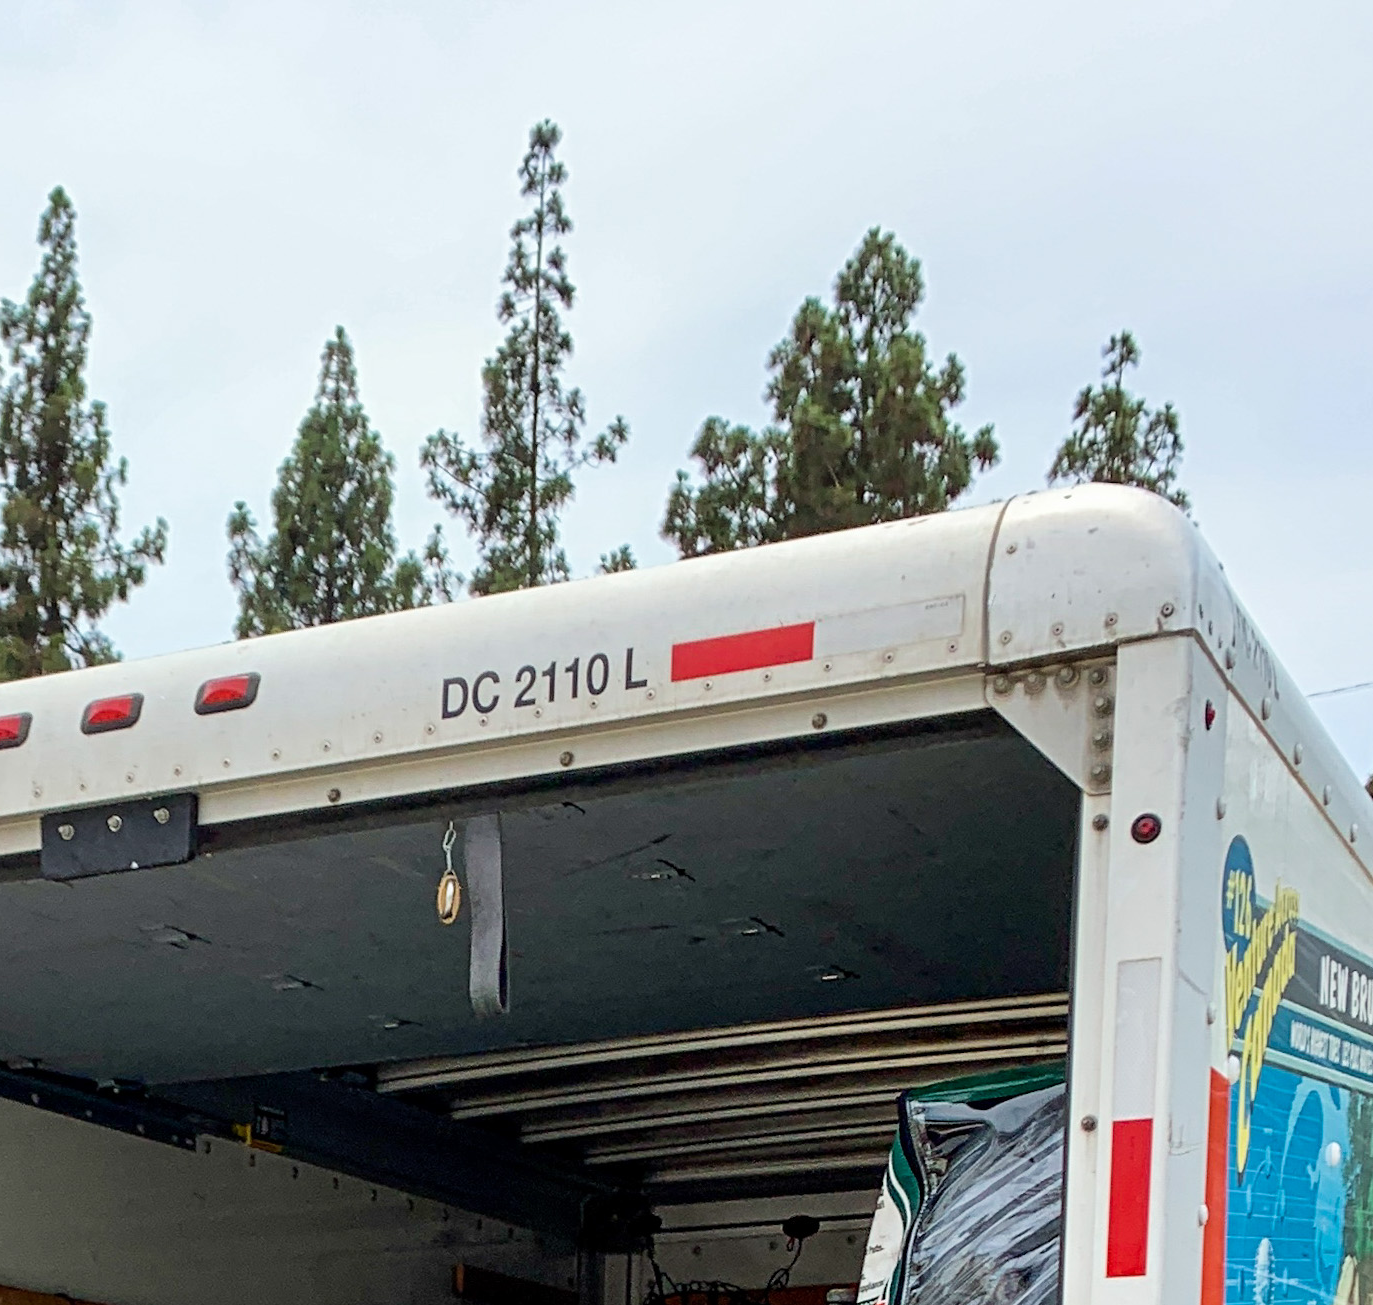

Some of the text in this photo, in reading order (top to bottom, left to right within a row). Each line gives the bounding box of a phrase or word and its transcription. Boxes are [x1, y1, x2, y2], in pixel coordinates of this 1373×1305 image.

[442, 648, 648, 720] DC 2110 L
[1319, 955, 1349, 1014] NEW
